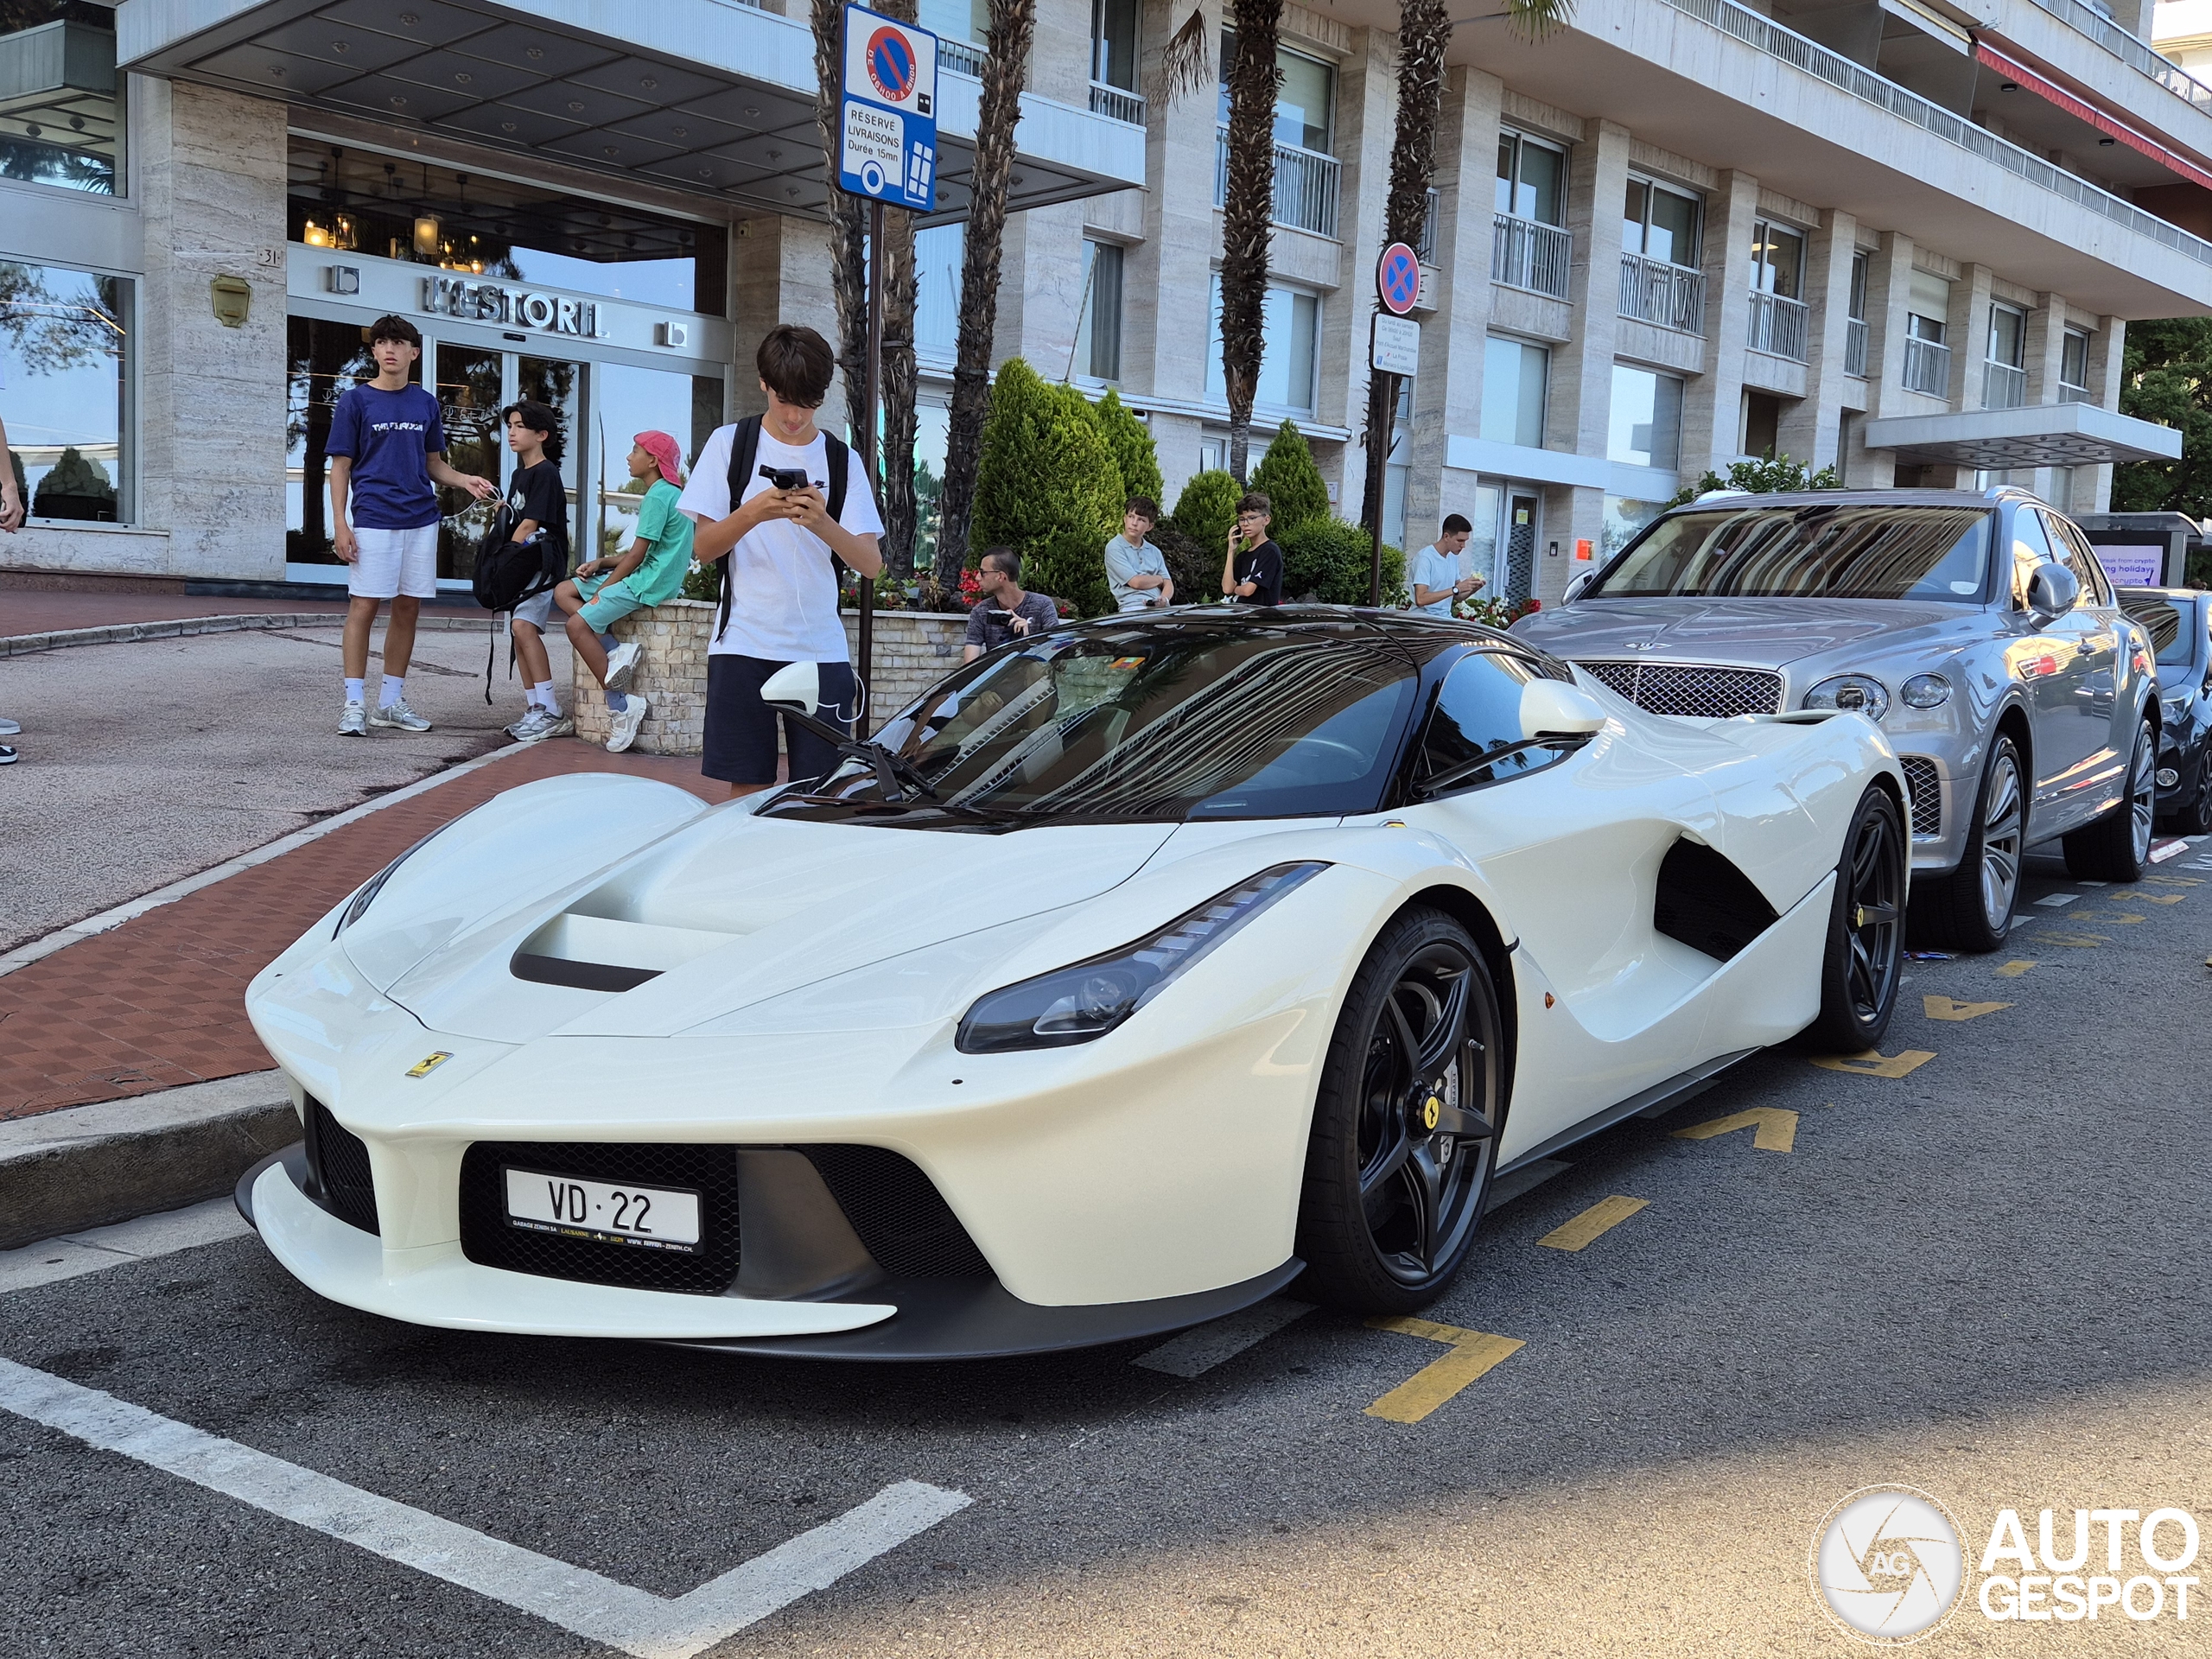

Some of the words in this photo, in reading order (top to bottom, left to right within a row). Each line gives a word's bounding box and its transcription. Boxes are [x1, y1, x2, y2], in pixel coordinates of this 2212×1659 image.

[868, 48, 874, 66] DE
[851, 109, 895, 131] RÉSERVÉ
[848, 124, 899, 148] LIVRAISONS
[848, 139, 874, 156] Durée
[877, 148, 898, 162] 15mn
[427, 275, 611, 339] L'ESTORIL
